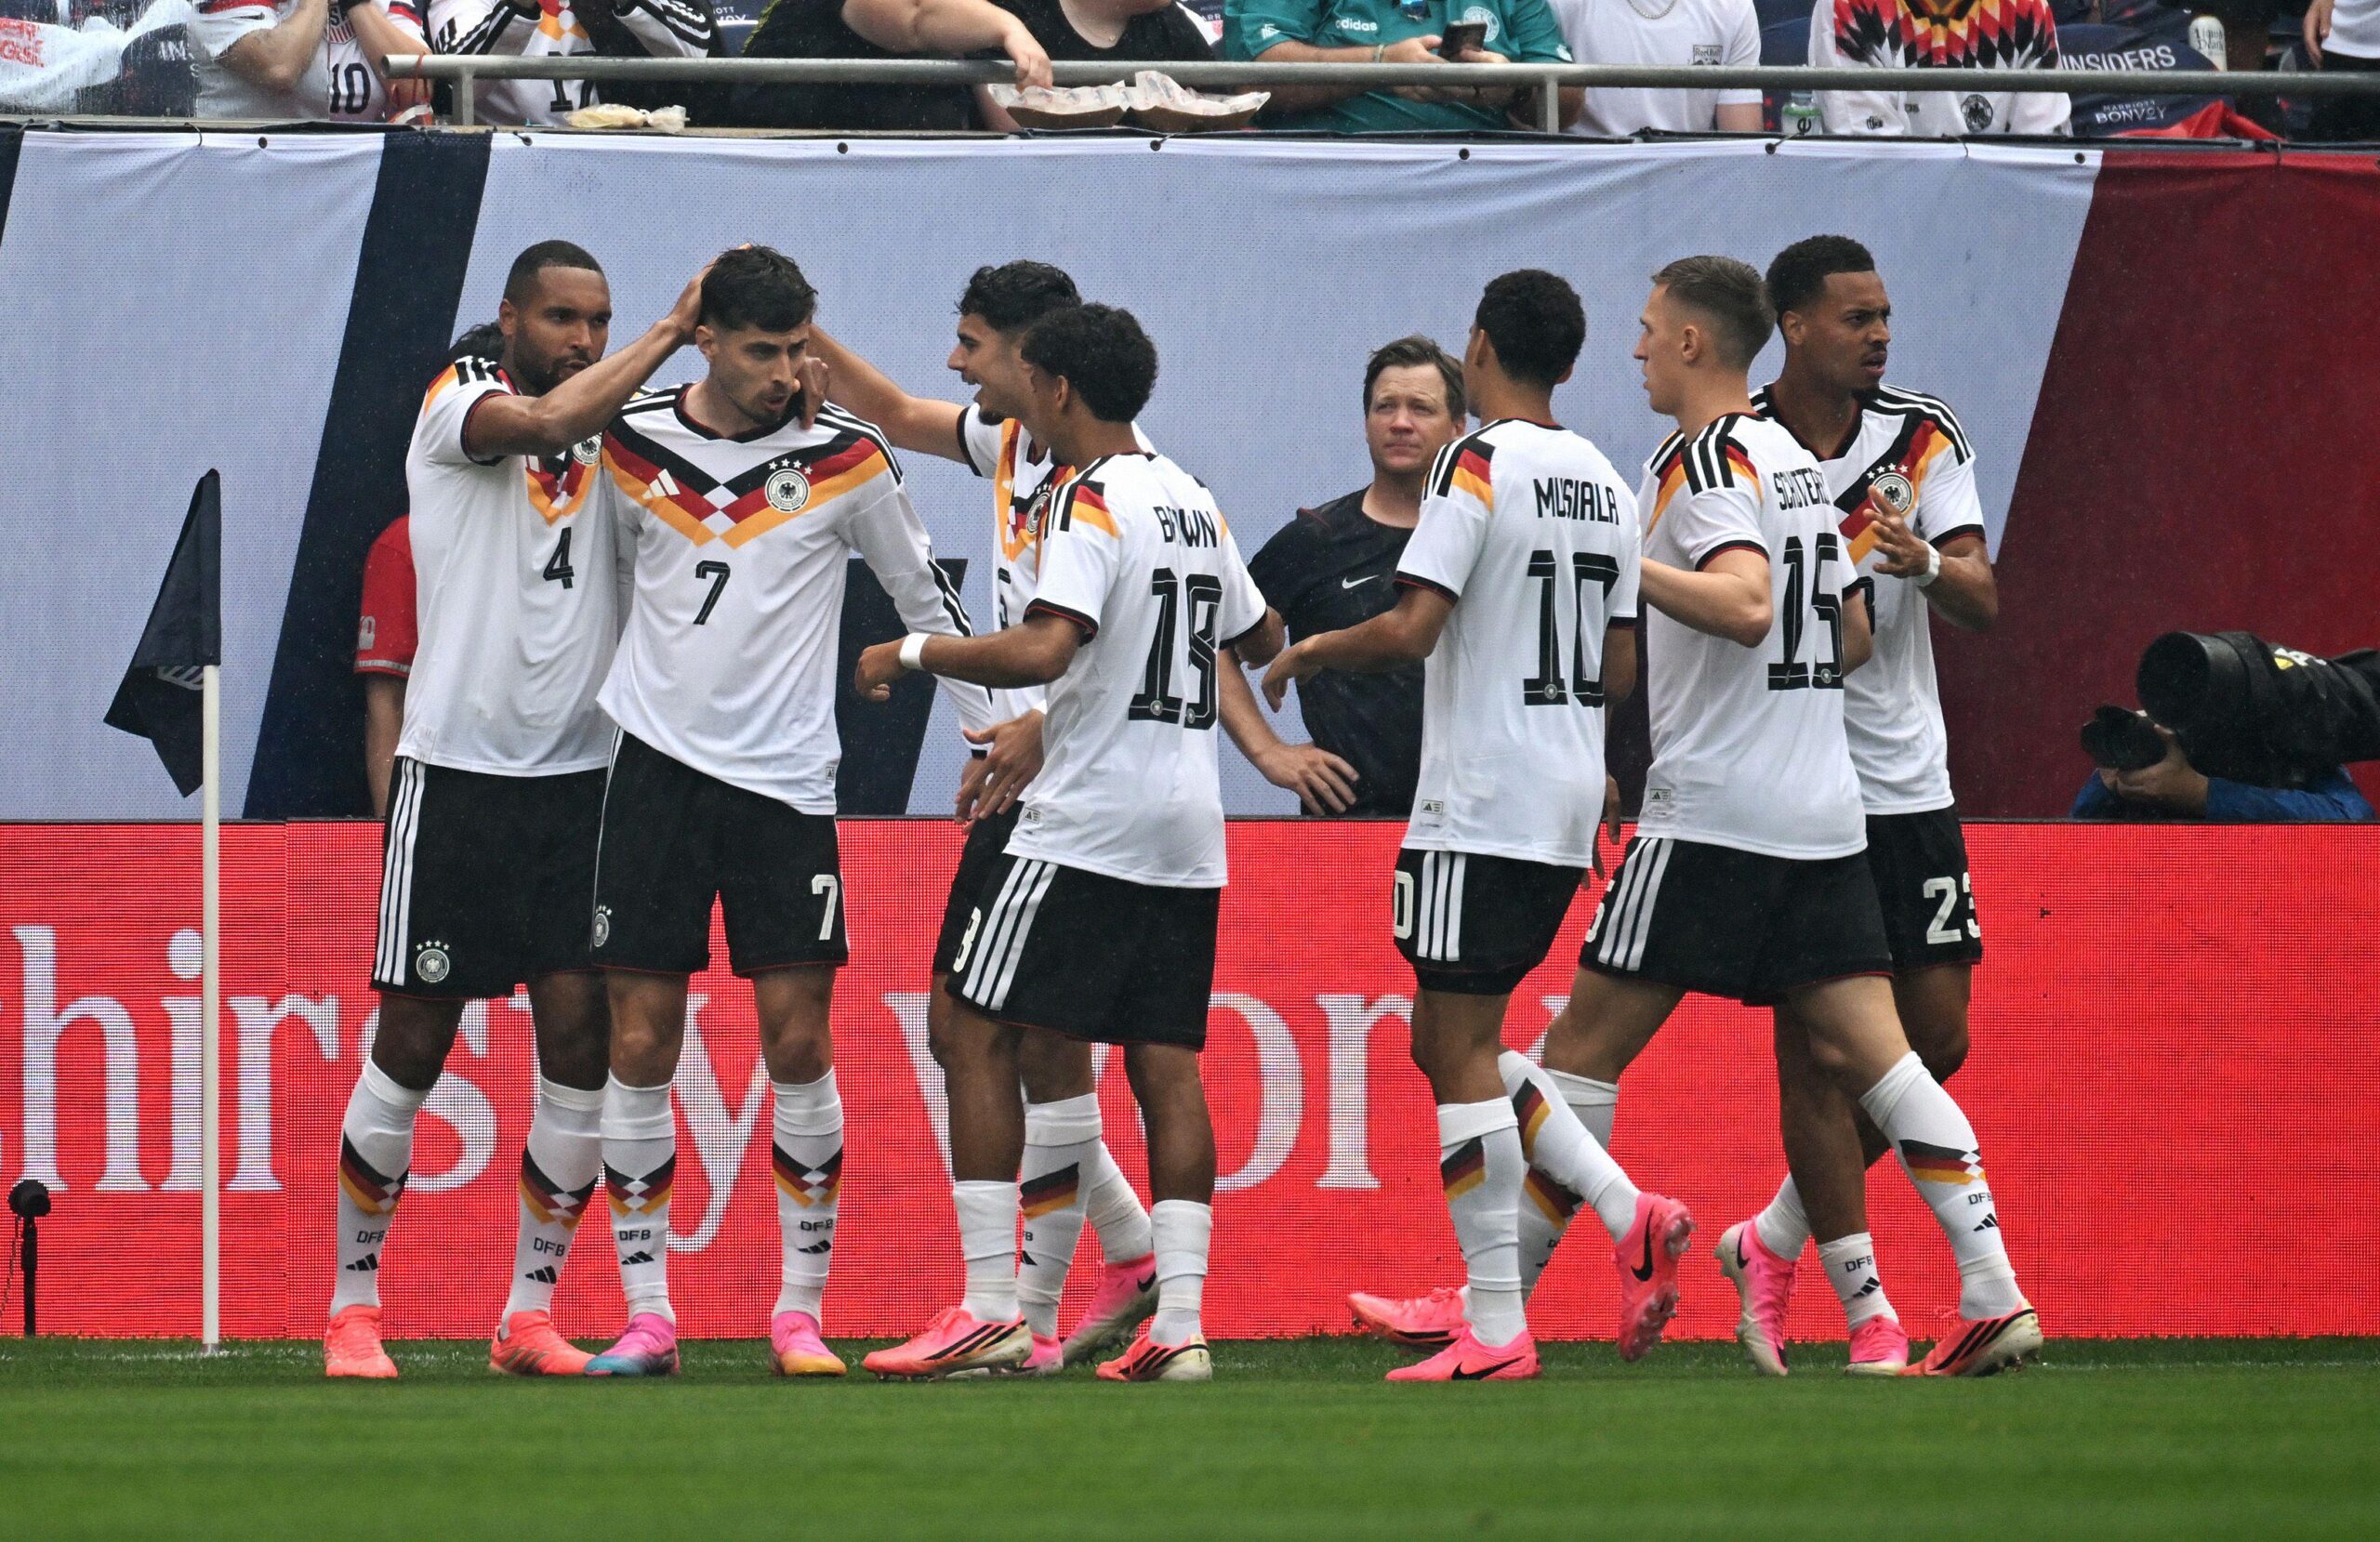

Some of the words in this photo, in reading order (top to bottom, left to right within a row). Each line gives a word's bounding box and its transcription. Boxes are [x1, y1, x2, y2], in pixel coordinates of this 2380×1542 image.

[1336, 18, 1378, 31] adidas
[2061, 46, 2176, 71] INSIDERS
[330, 62, 371, 114] 10
[2095, 107, 2167, 125] BONVOY
[2103, 99, 2156, 112] MARRIOTT
[1533, 477, 1620, 525] MUSIALA
[1153, 506, 1217, 548] BWN
[543, 527, 575, 589] 4
[693, 560, 731, 626] 7
[1523, 549, 1620, 708] 10
[1768, 533, 1845, 691] 15
[811, 874, 839, 941] 7
[11, 924, 772, 1253] hirsy
[356, 1230, 385, 1244] DFB
[619, 1229, 651, 1241] DFB
[800, 1219, 833, 1232] DFB
[534, 1237, 565, 1257] DFB
[1845, 1255, 1872, 1272] DFB
